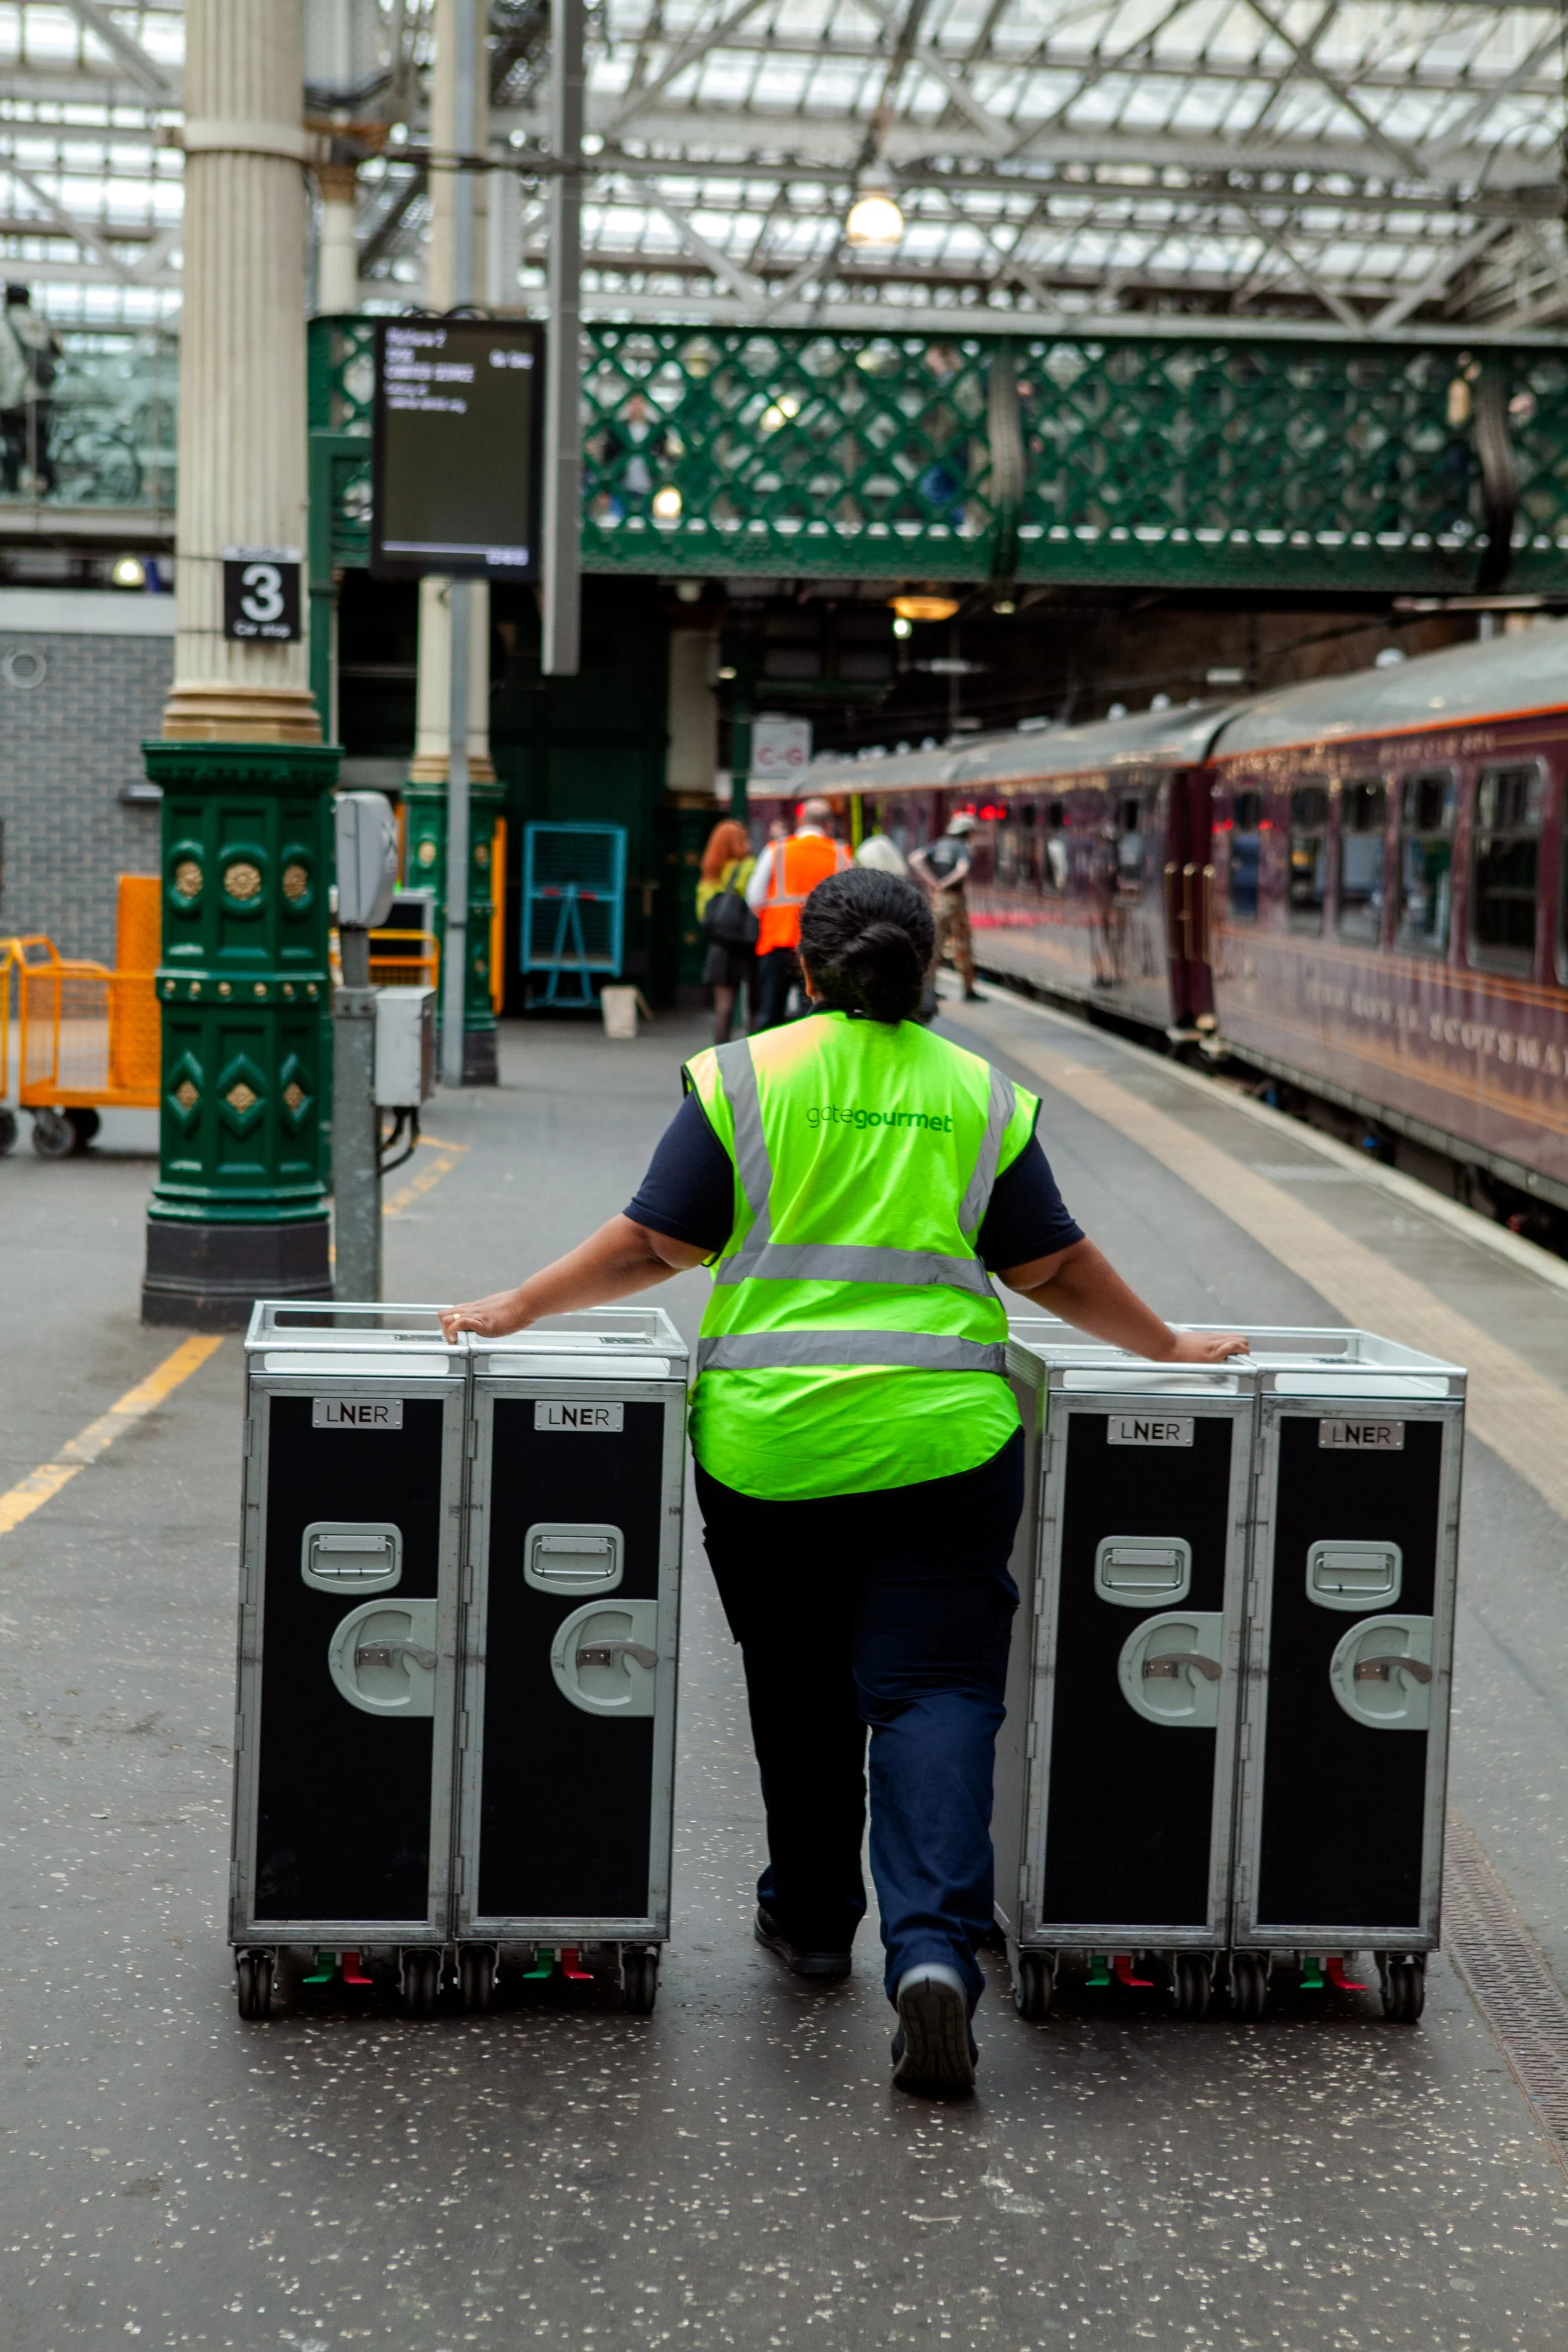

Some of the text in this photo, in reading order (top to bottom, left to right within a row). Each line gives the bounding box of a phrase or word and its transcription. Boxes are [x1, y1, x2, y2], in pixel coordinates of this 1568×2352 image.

[241, 563, 285, 622] 3
[327, 1402, 388, 1425] LNER
[549, 1404, 609, 1428] LNER
[1121, 1419, 1180, 1442] LNER
[1333, 1424, 1391, 1445] LNER
